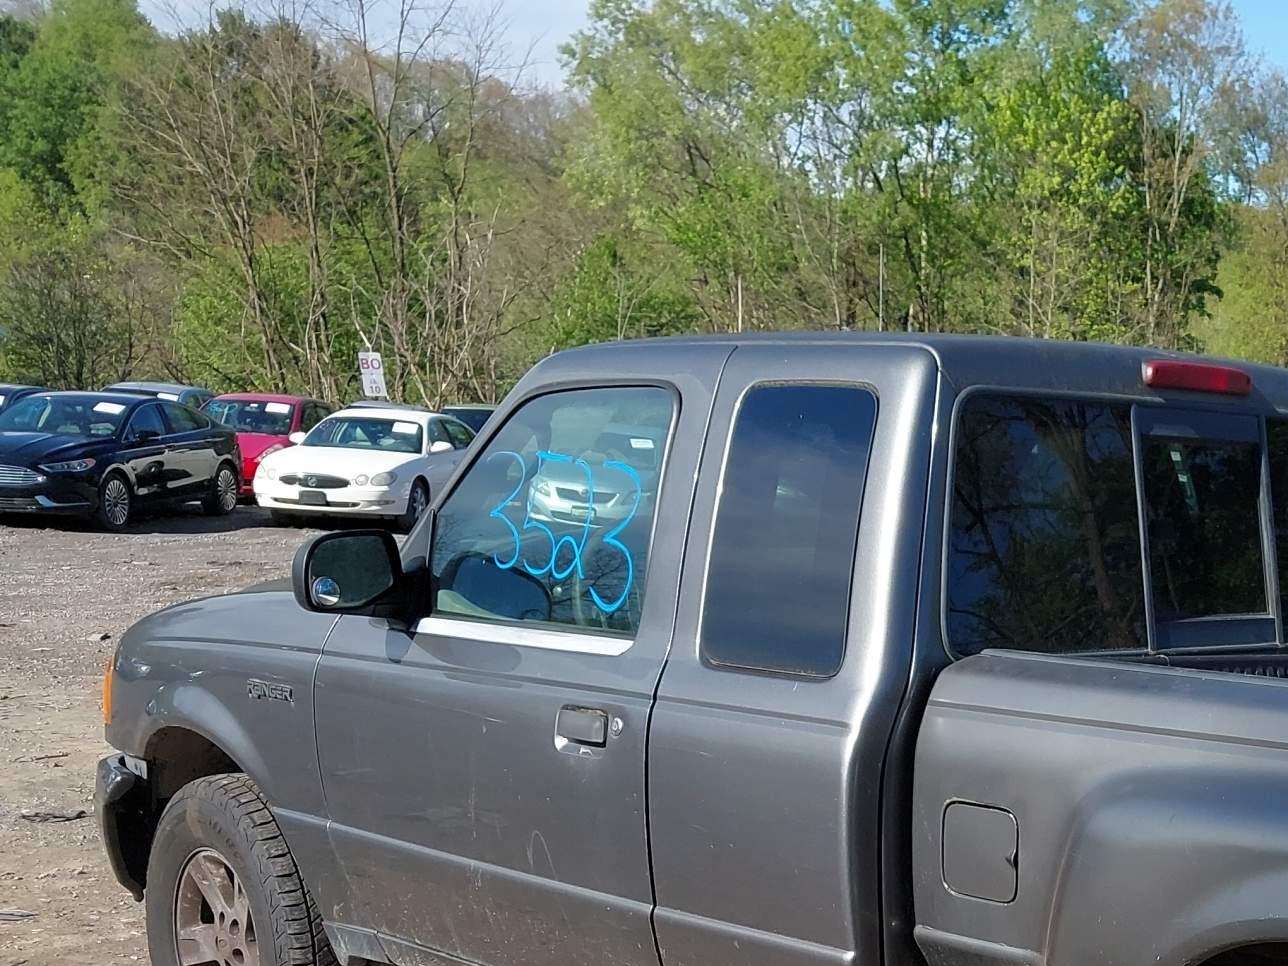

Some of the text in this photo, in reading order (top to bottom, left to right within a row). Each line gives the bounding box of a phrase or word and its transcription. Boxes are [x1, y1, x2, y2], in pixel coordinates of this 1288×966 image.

[369, 385, 381, 394] 10
[487, 450, 642, 613] 3523
[247, 678, 293, 702] RANGER
